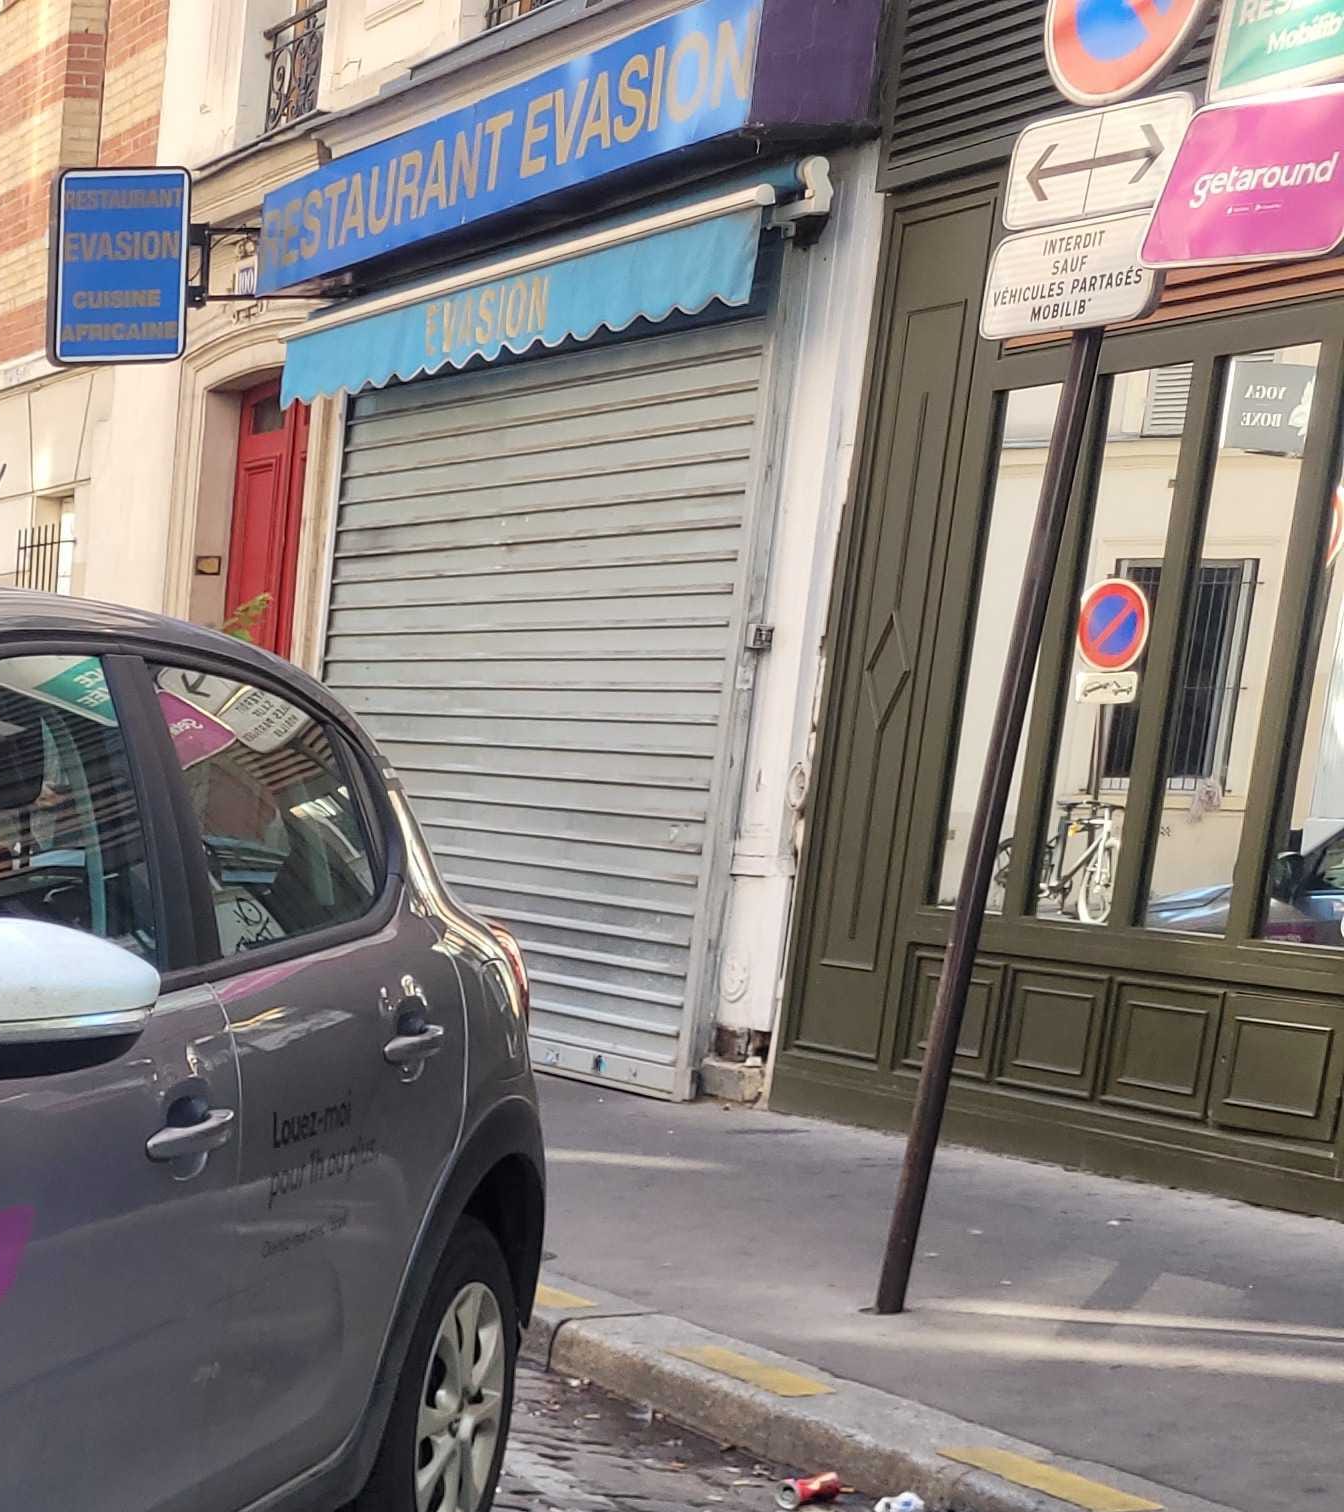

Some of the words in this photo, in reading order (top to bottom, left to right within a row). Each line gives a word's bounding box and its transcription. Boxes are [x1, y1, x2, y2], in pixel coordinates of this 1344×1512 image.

[263, 110, 513, 267] RESTAURANT
[520, 12, 760, 178] EVASION
[1189, 151, 1340, 209] getaround
[63, 188, 184, 211] RESTAURANT
[63, 230, 180, 262] EVASION
[1043, 231, 1105, 256] INTERDIT
[1051, 255, 1088, 275] SAUF
[72, 289, 161, 310] CUISINE
[993, 281, 1064, 307] VÉHICULES
[1070, 266, 1143, 295] PARTAGÉS
[424, 276, 550, 357] EVASION
[62, 320, 178, 342] AFRICAINE
